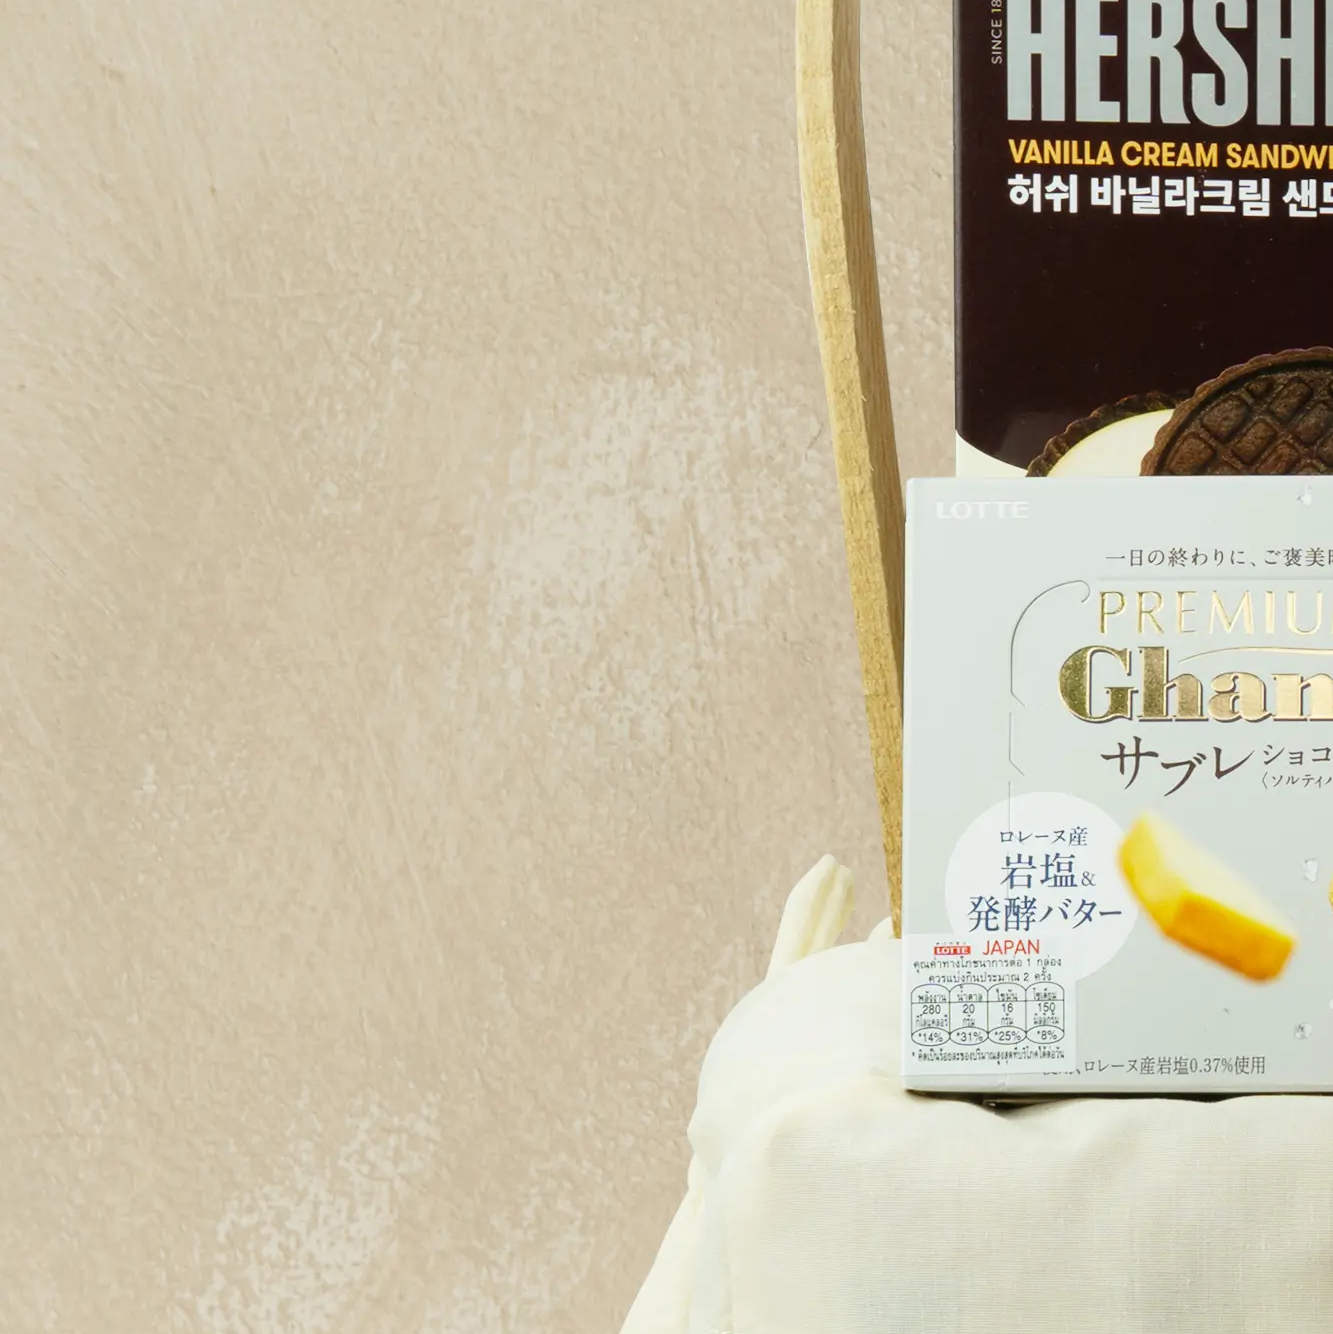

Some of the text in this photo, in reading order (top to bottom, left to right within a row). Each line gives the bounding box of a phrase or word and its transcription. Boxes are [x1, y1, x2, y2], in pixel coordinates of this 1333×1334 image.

[991, 19, 1002, 65] SINCE
[1008, 138, 1114, 165] VANILLA
[1121, 141, 1218, 167] CREAM
[1008, 173, 1078, 213] 허쉬
[1091, 175, 1271, 217] 바닐라크림
[936, 499, 1030, 520] LOTTE
[1101, 735, 1255, 797] サブレ
[1000, 825, 1088, 847] ロレーヌ産
[1000, 852, 1096, 889] 岩塩&
[967, 895, 1122, 933] 発酵バター
[935, 939, 1040, 956] LOTTE JAPAN
[922, 1002, 1056, 1014] 280 20 16 150
